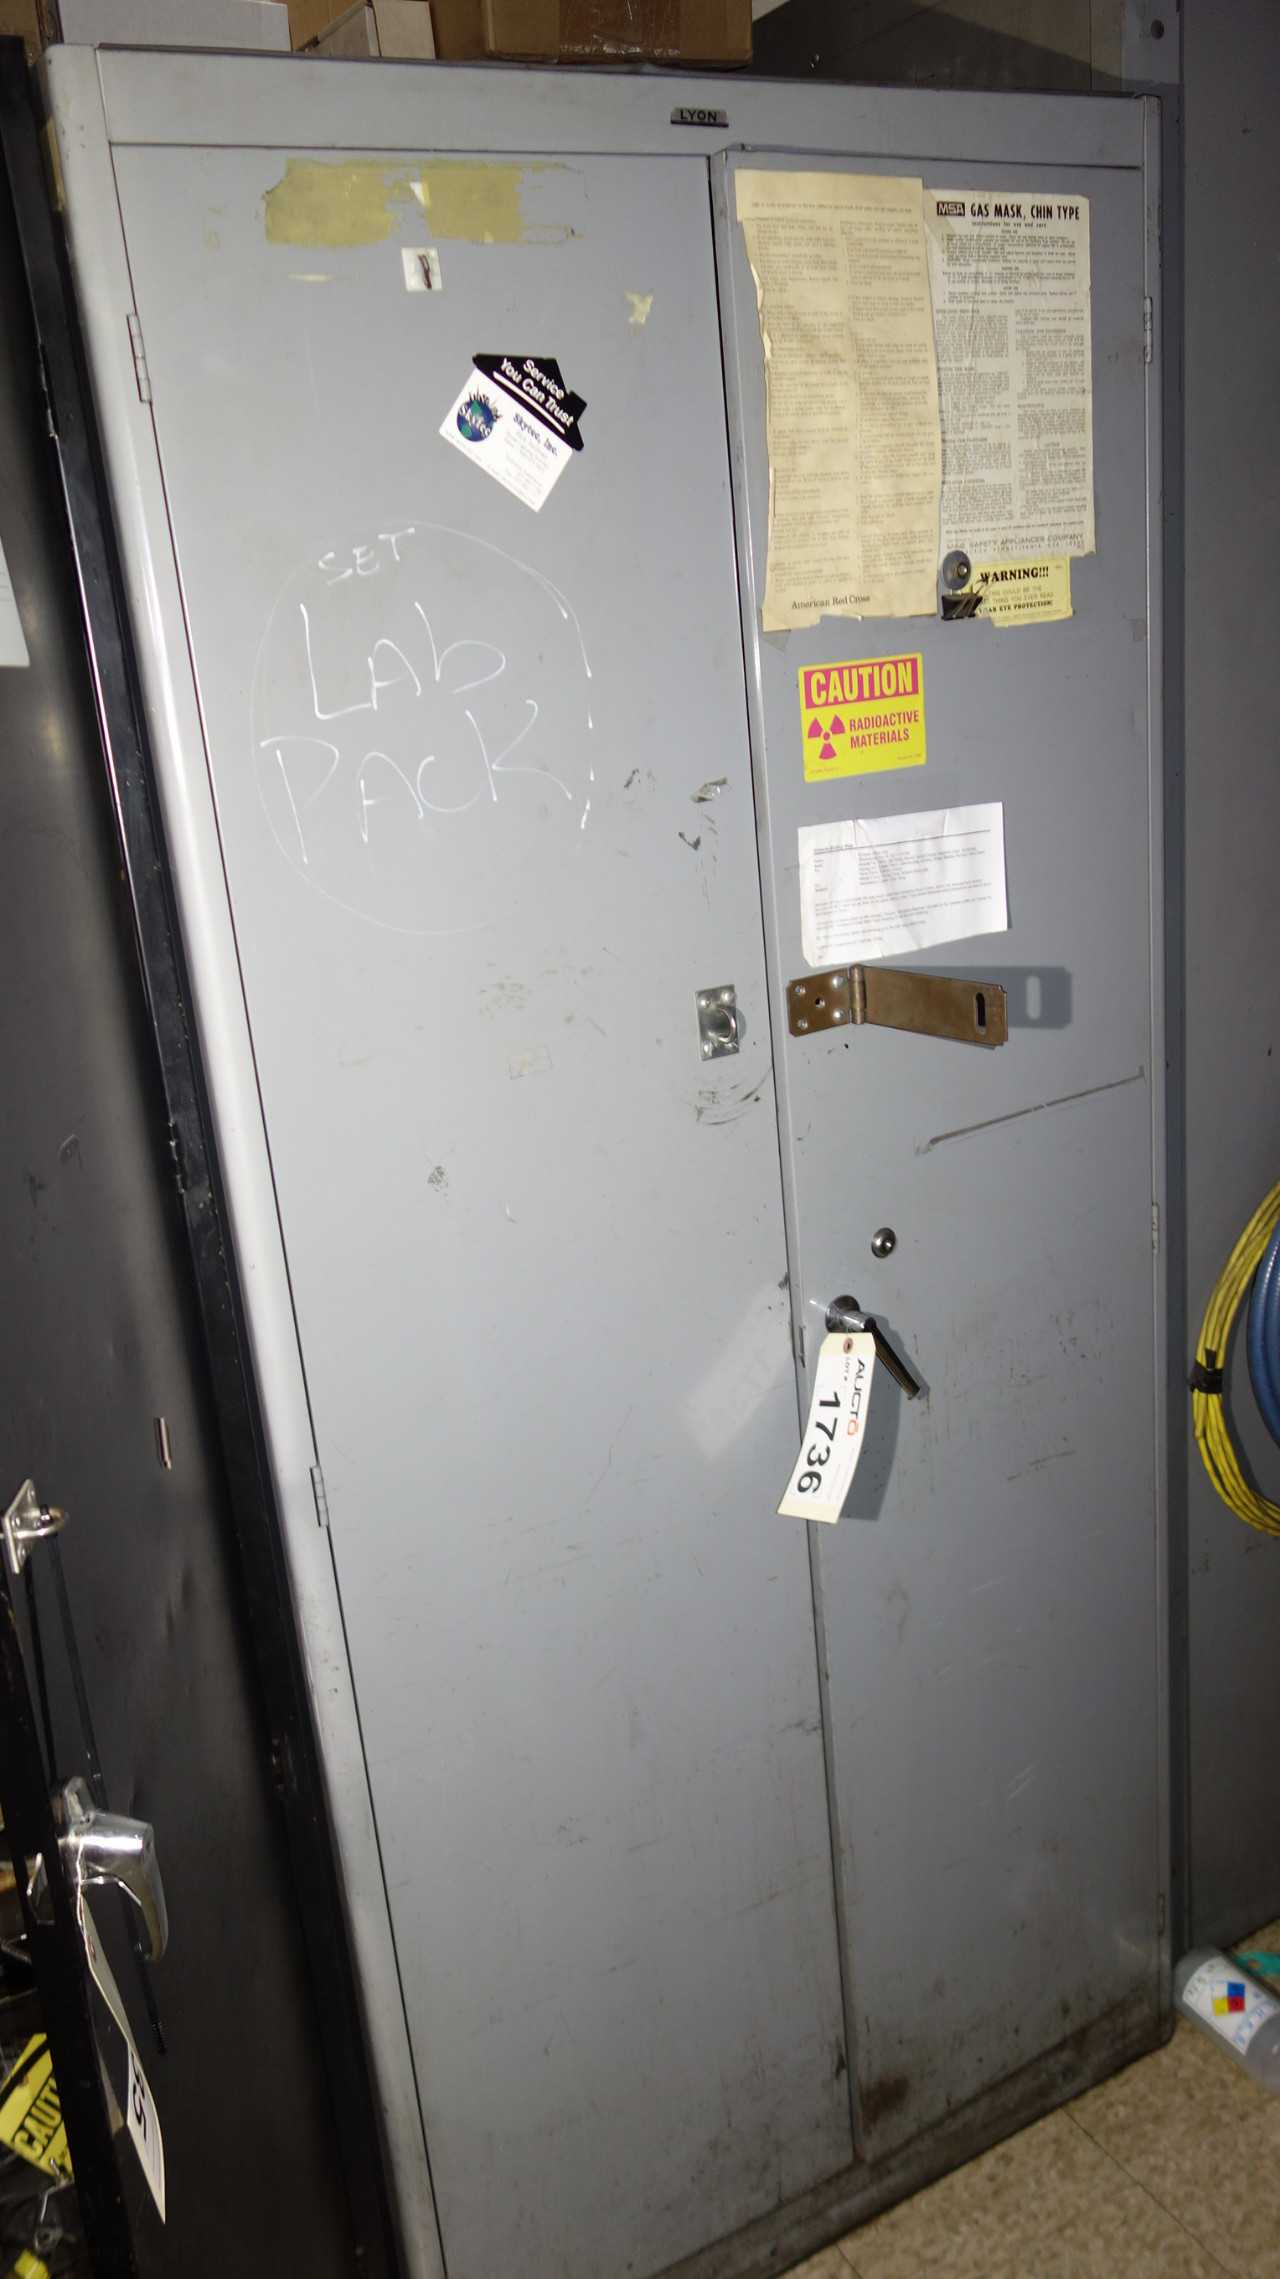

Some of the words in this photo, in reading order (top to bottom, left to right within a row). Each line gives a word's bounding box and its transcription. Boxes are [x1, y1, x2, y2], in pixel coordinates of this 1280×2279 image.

[680, 109, 717, 122] LYON
[938, 202, 965, 216] MSA
[970, 203, 989, 218] GAS
[994, 204, 1026, 221] MASK,
[1030, 205, 1053, 220] CHIN
[1057, 206, 1080, 221] TYPE
[500, 357, 523, 384] You
[522, 378, 546, 404] Can
[545, 395, 575, 428] Trust
[523, 359, 565, 401] Service
[456, 404, 492, 438] Skytec
[318, 528, 416, 586] SET
[980, 566, 1049, 584] WARNING!!!
[792, 600, 830, 609] American
[832, 596, 848, 605] Red
[810, 661, 913, 706] CAUTION
[849, 710, 920, 733] RADIOACTIVE
[850, 728, 910, 750] MATERIALS
[260, 699, 573, 865] PACK
[848, 1357, 866, 1437] AUCTO
[797, 1391, 841, 1494] 1736
